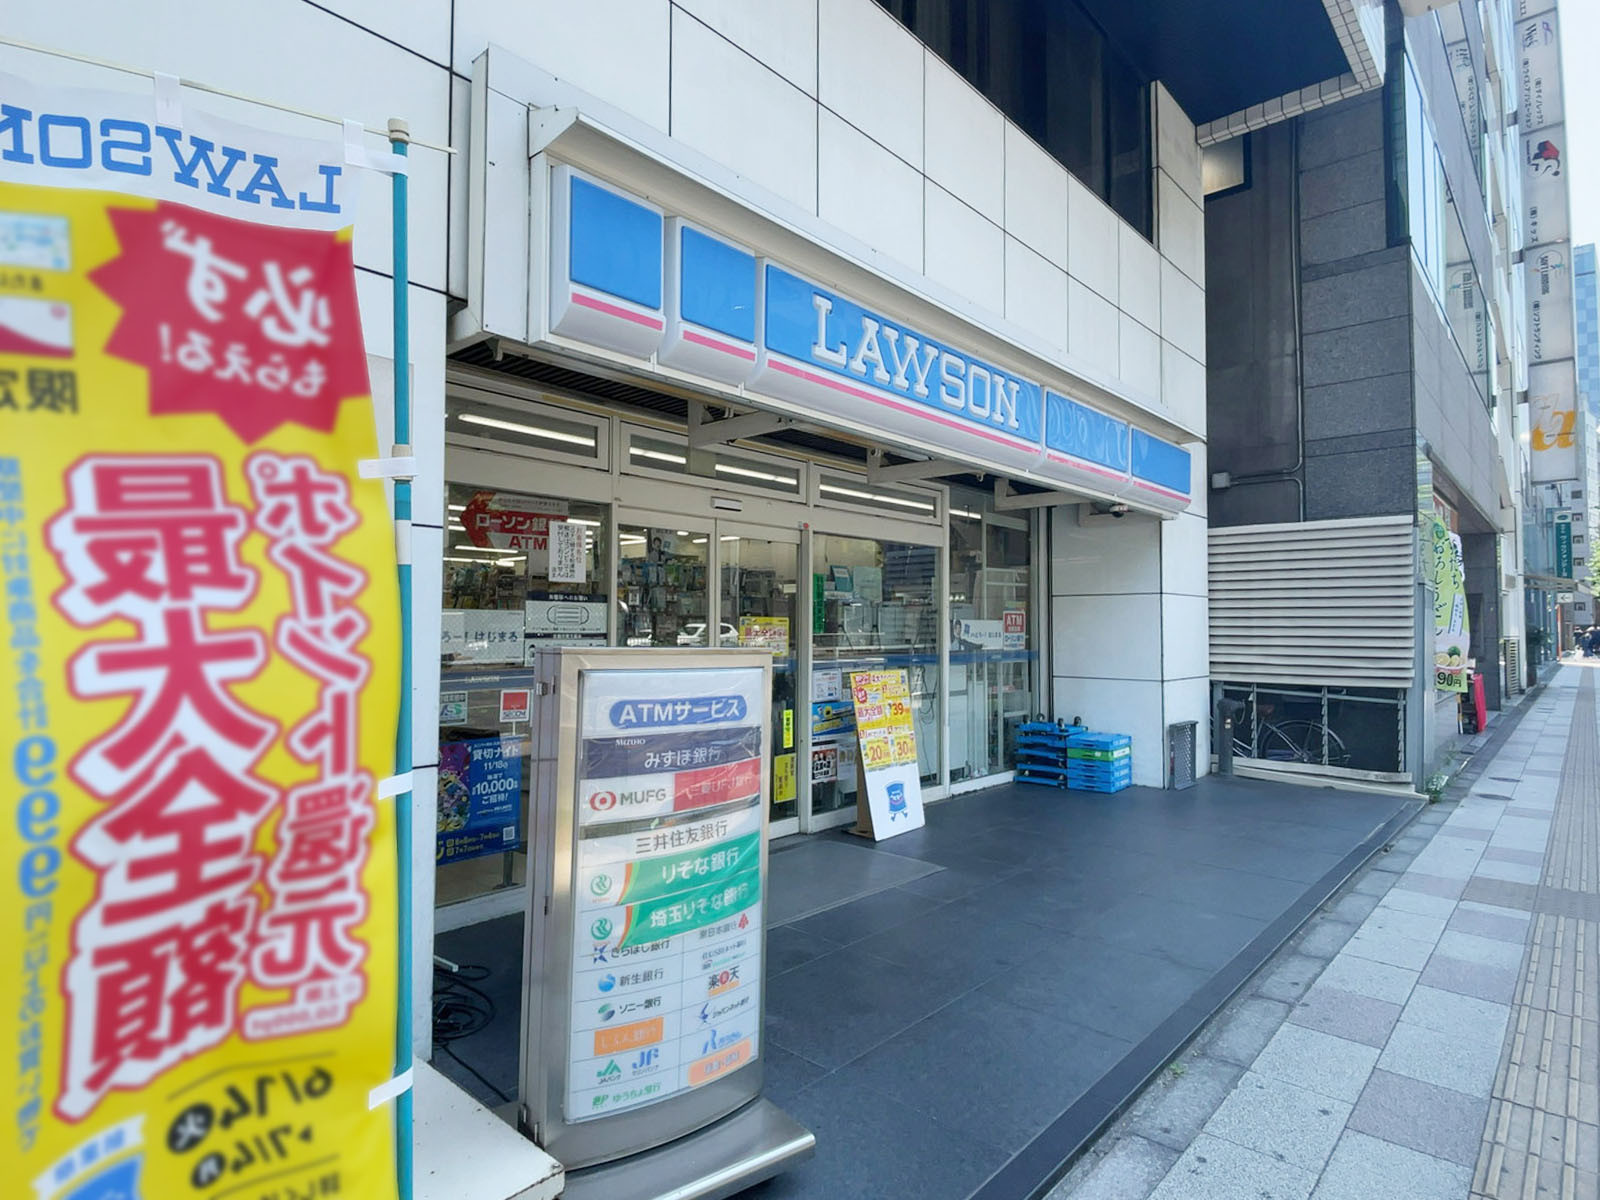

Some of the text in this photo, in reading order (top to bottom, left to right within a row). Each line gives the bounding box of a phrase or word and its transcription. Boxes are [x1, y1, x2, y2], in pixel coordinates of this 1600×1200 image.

[811, 292, 1020, 431] LAWSON
[476, 513, 551, 532] ローソン銀
[509, 536, 548, 551] ATM
[1006, 614, 1023, 626] ATM
[474, 631, 518, 643] はじまる
[618, 698, 740, 725] ATMサービス
[644, 745, 722, 769] みずほ銀行
[620, 788, 667, 806] MUFG
[635, 820, 728, 855] 三井住友銀行
[662, 846, 740, 884] りそな銀行
[650, 882, 749, 928] 埼玉りそな銀行
[619, 968, 664, 987] 新生銀行
[619, 996, 662, 1015] ソニー銀行
